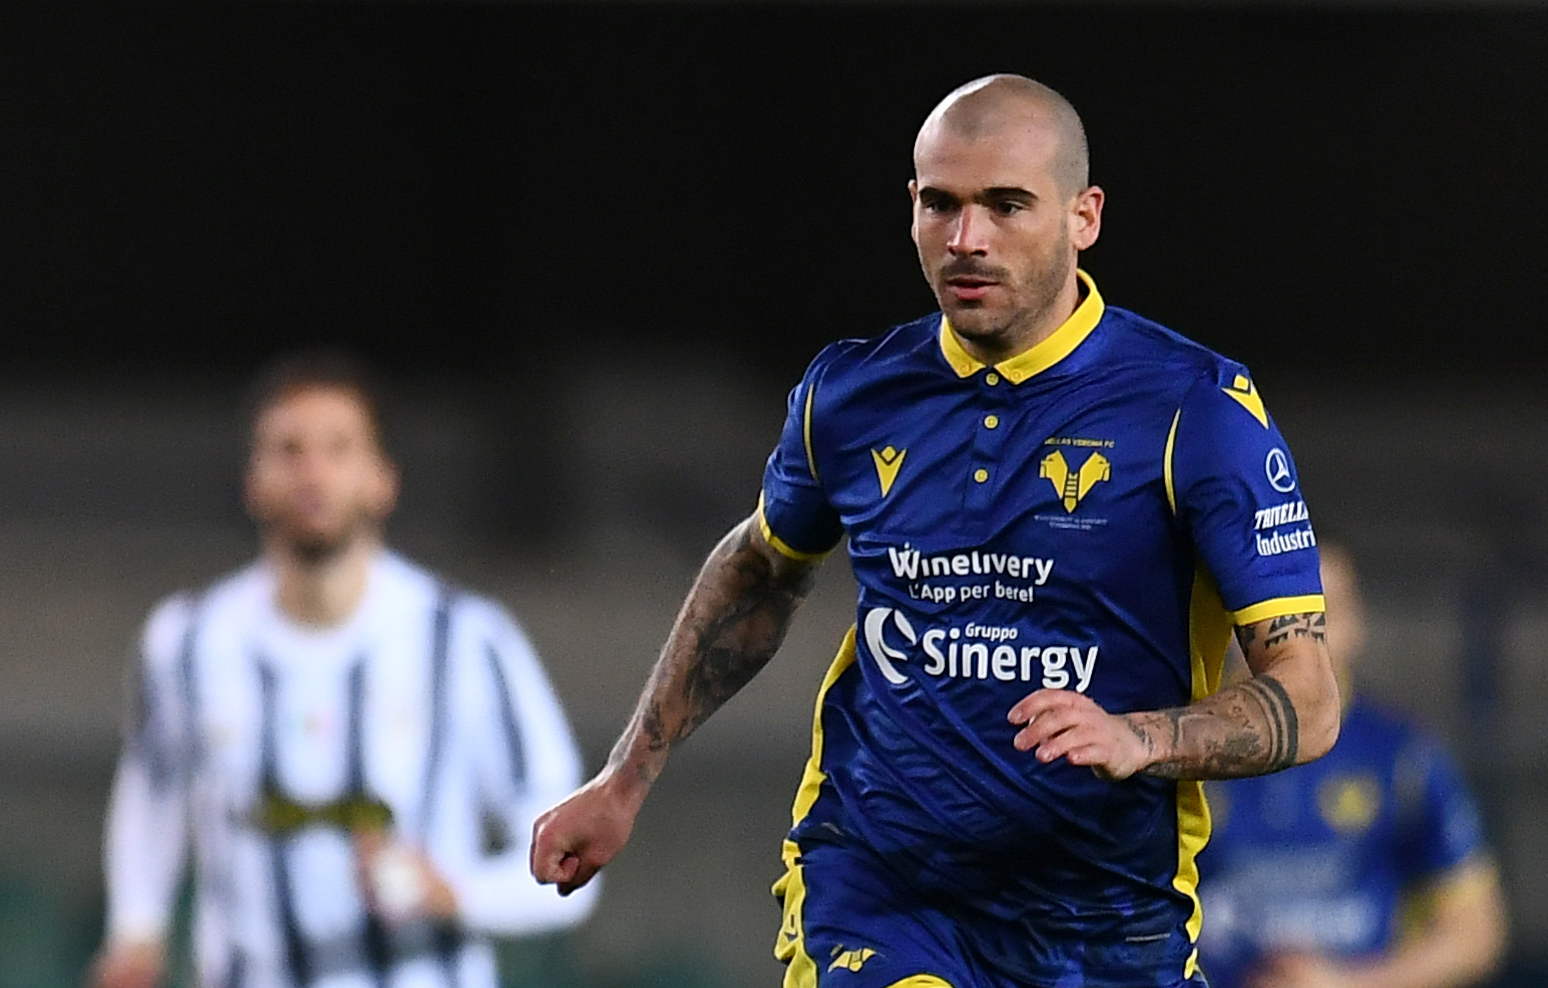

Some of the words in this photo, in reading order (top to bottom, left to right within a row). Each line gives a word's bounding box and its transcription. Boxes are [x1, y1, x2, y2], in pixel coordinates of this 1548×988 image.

[887, 541, 1054, 586] Winelivery
[909, 583, 956, 603] L'App
[960, 584, 991, 603] per
[965, 622, 1018, 642] Gruppo
[922, 627, 1099, 693] Sinergy
